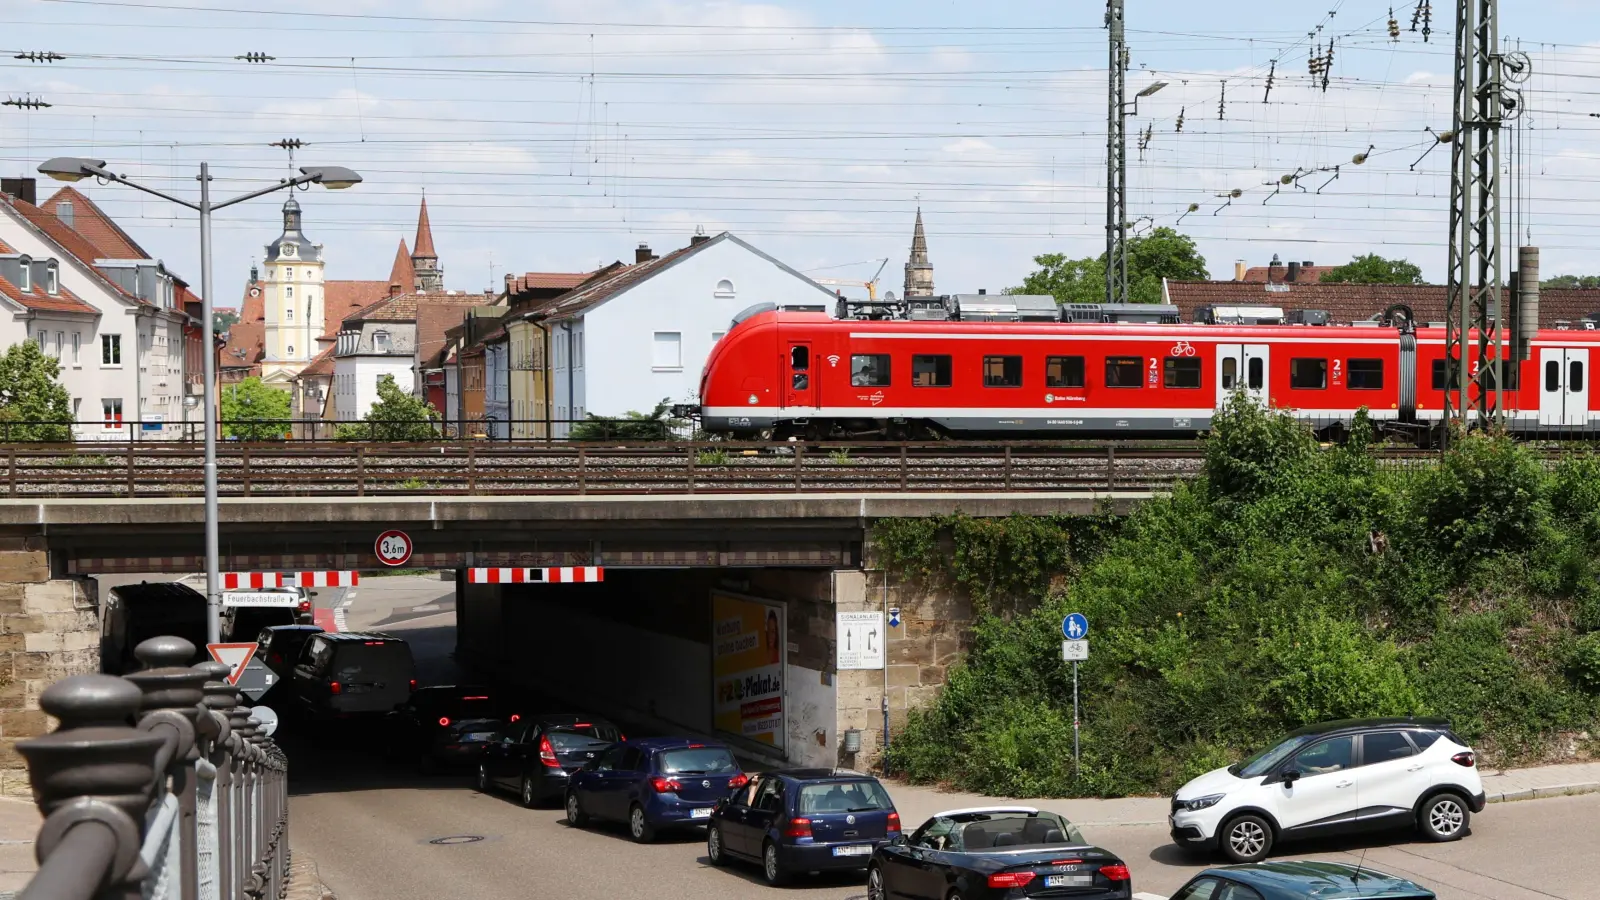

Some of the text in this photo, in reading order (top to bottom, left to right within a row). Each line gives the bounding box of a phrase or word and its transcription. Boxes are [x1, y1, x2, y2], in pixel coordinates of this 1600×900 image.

[1149, 357, 1158, 369] 2
[1333, 359, 1341, 370] 2
[1472, 360, 1479, 372] 2
[227, 594, 285, 603] Feuerbachstraße
[1050, 876, 1060, 884] AN
